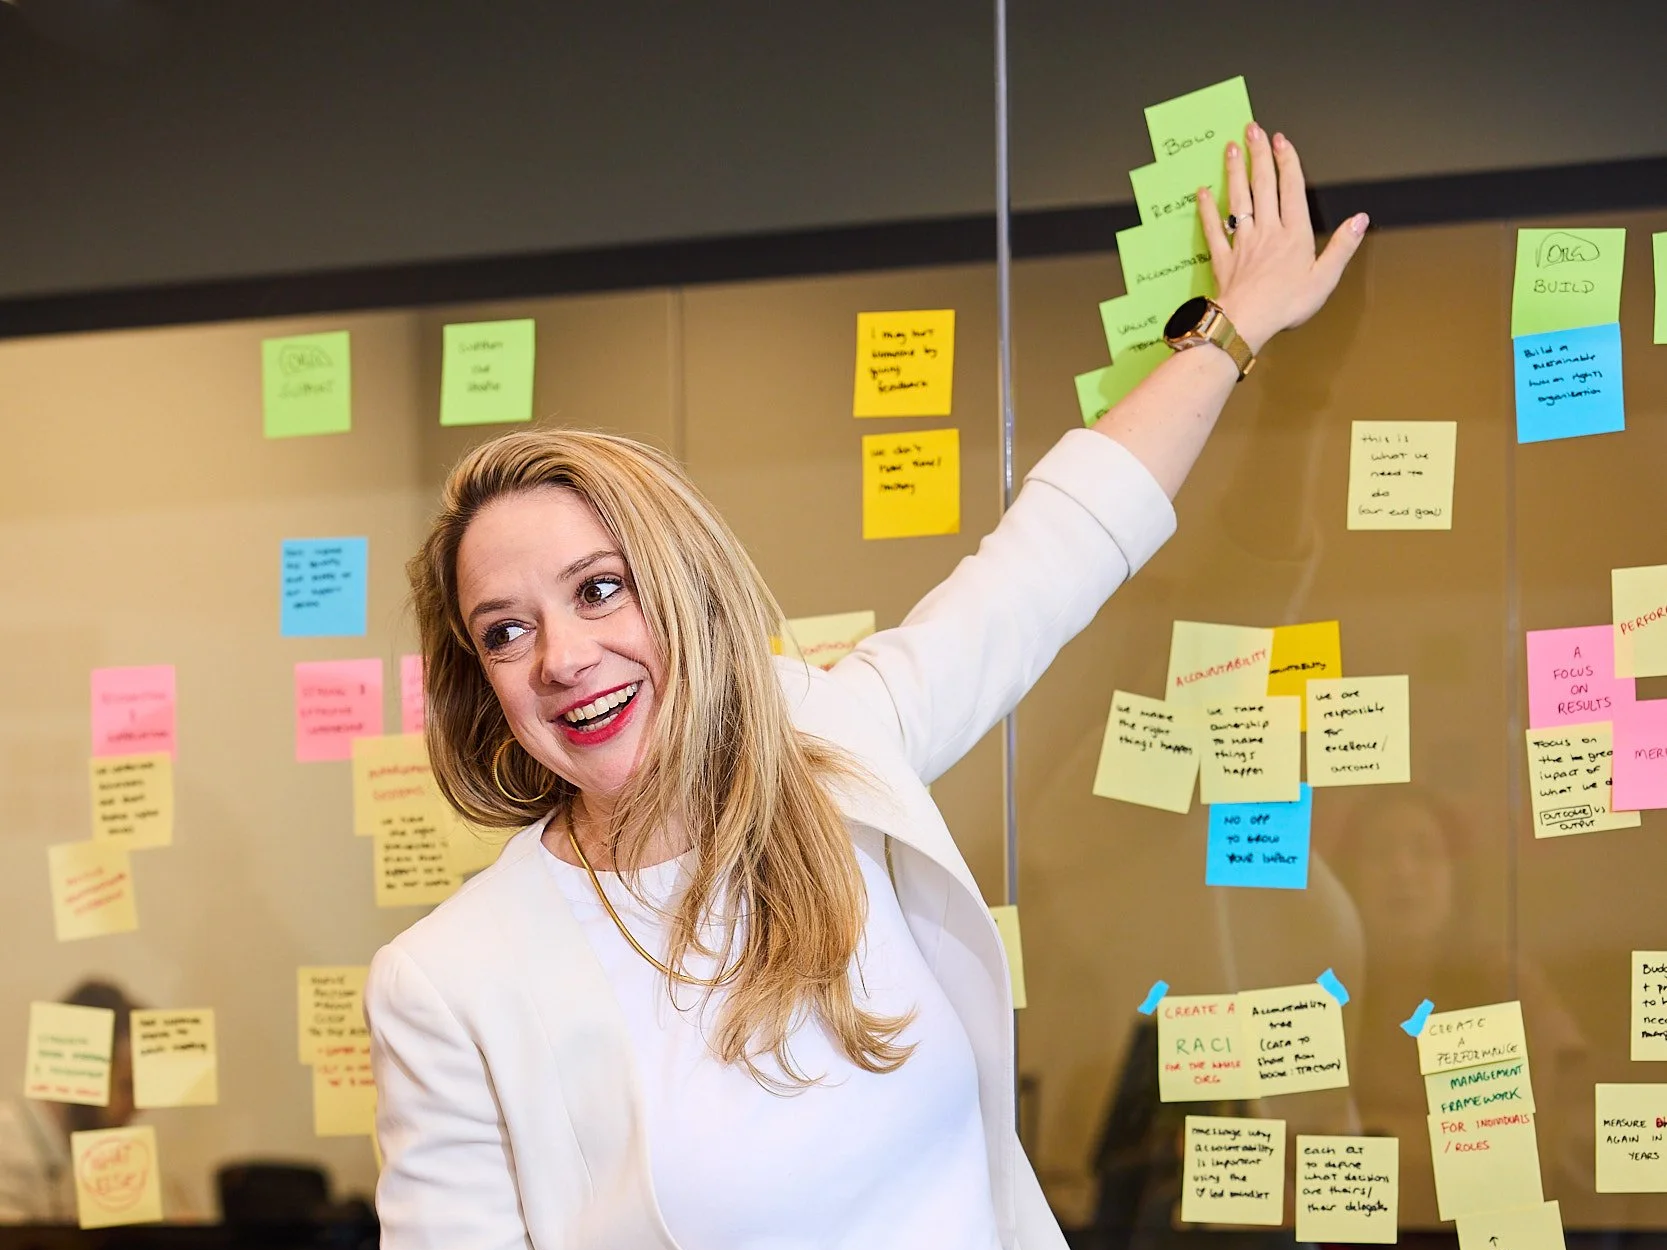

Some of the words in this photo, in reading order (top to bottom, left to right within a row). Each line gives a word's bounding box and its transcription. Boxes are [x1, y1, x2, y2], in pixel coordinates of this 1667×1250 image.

[1534, 279, 1595, 294] BUILD
[1524, 346, 1553, 358] Build
[1371, 451, 1408, 461] what
[1370, 468, 1401, 477] need
[1371, 488, 1390, 498] do
[1620, 605, 1667, 635] PERFOR
[1574, 646, 1581, 658] A
[1175, 649, 1267, 687] ACCOUNTABILITY
[1553, 665, 1594, 679] FOCUS
[1570, 683, 1588, 695] ON
[1316, 693, 1332, 701] we
[1341, 690, 1359, 699] are
[1323, 702, 1384, 719] responsible
[1558, 697, 1612, 715] RESULTS
[1323, 728, 1343, 737] for
[1215, 749, 1255, 763] things
[1588, 750, 1613, 762] grea
[1635, 748, 1667, 760] MER
[1223, 765, 1263, 778] happen
[1587, 765, 1601, 774] of
[1540, 786, 1572, 796] what
[1583, 782, 1597, 790] we
[1560, 820, 1595, 830] OUTPUT
[1642, 999, 1656, 1008] to
[1165, 1003, 1218, 1019] CREATE
[1227, 1002, 1235, 1014] A
[1429, 1018, 1486, 1037] CREATE
[1176, 1037, 1231, 1055] RACI
[1458, 1037, 1465, 1047] A
[1437, 1043, 1518, 1066] PERFORMANCE
[1165, 1063, 1181, 1071] FOR
[1450, 1064, 1524, 1090] MANAGEMENT
[1441, 1087, 1522, 1114] FRAMEWORK
[1441, 1122, 1466, 1134] FOR
[1476, 1114, 1530, 1129] INDIVIDUALS
[1603, 1118, 1647, 1128] MEASURE
[1606, 1135, 1639, 1144] AGAIN
[1304, 1147, 1335, 1155] each
[1455, 1140, 1490, 1153] ROLES
[1628, 1152, 1660, 1161] YEARS
